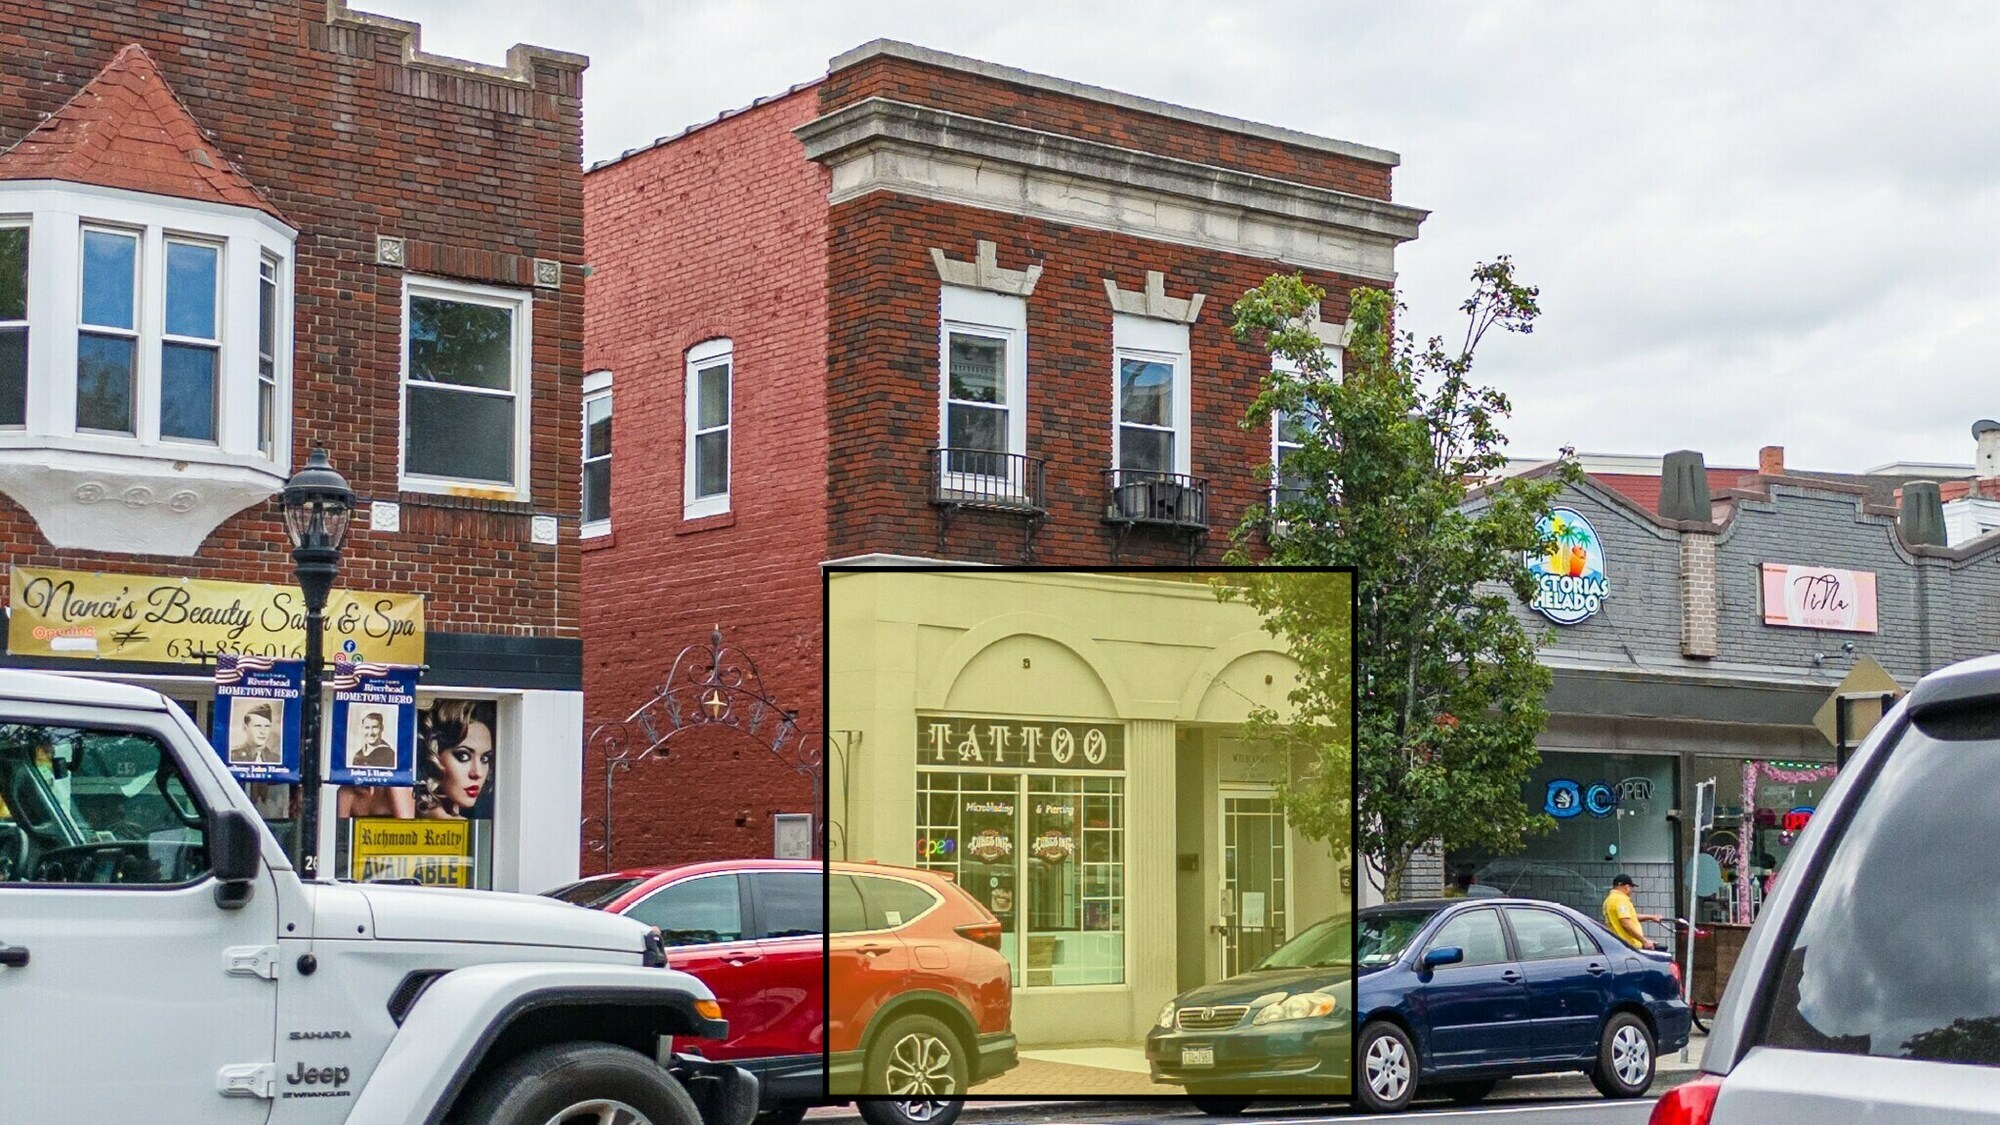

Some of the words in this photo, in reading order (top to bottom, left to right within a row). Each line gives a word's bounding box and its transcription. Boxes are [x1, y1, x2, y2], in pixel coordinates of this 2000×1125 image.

[1535, 573, 1609, 596] CTORIAS
[23, 577, 138, 622] Nanci's
[145, 586, 254, 639] Beauty
[261, 593, 332, 632] Saln
[338, 602, 360, 634] &
[364, 600, 415, 645] Spa
[1534, 591, 1598, 612] HELADO
[167, 638, 303, 659] 631-856-016
[218, 685, 272, 697] HOMETOWN
[274, 688, 299, 698] HERO
[247, 677, 290, 687] Riverhead
[364, 684, 404, 693] Riverhead
[336, 692, 387, 703] HOMETOWN
[388, 694, 413, 704] HERO
[928, 723, 1107, 764] TATTOO
[1615, 782, 1651, 800] OPEN
[966, 801, 1014, 816] Microblading
[1045, 804, 1075, 817] Piercing
[362, 828, 418, 848] Richmond
[424, 829, 462, 849] Realty
[362, 856, 458, 884] AVAILABLE
[289, 1031, 351, 1040] SAHARA
[286, 1062, 350, 1088] Jeep
